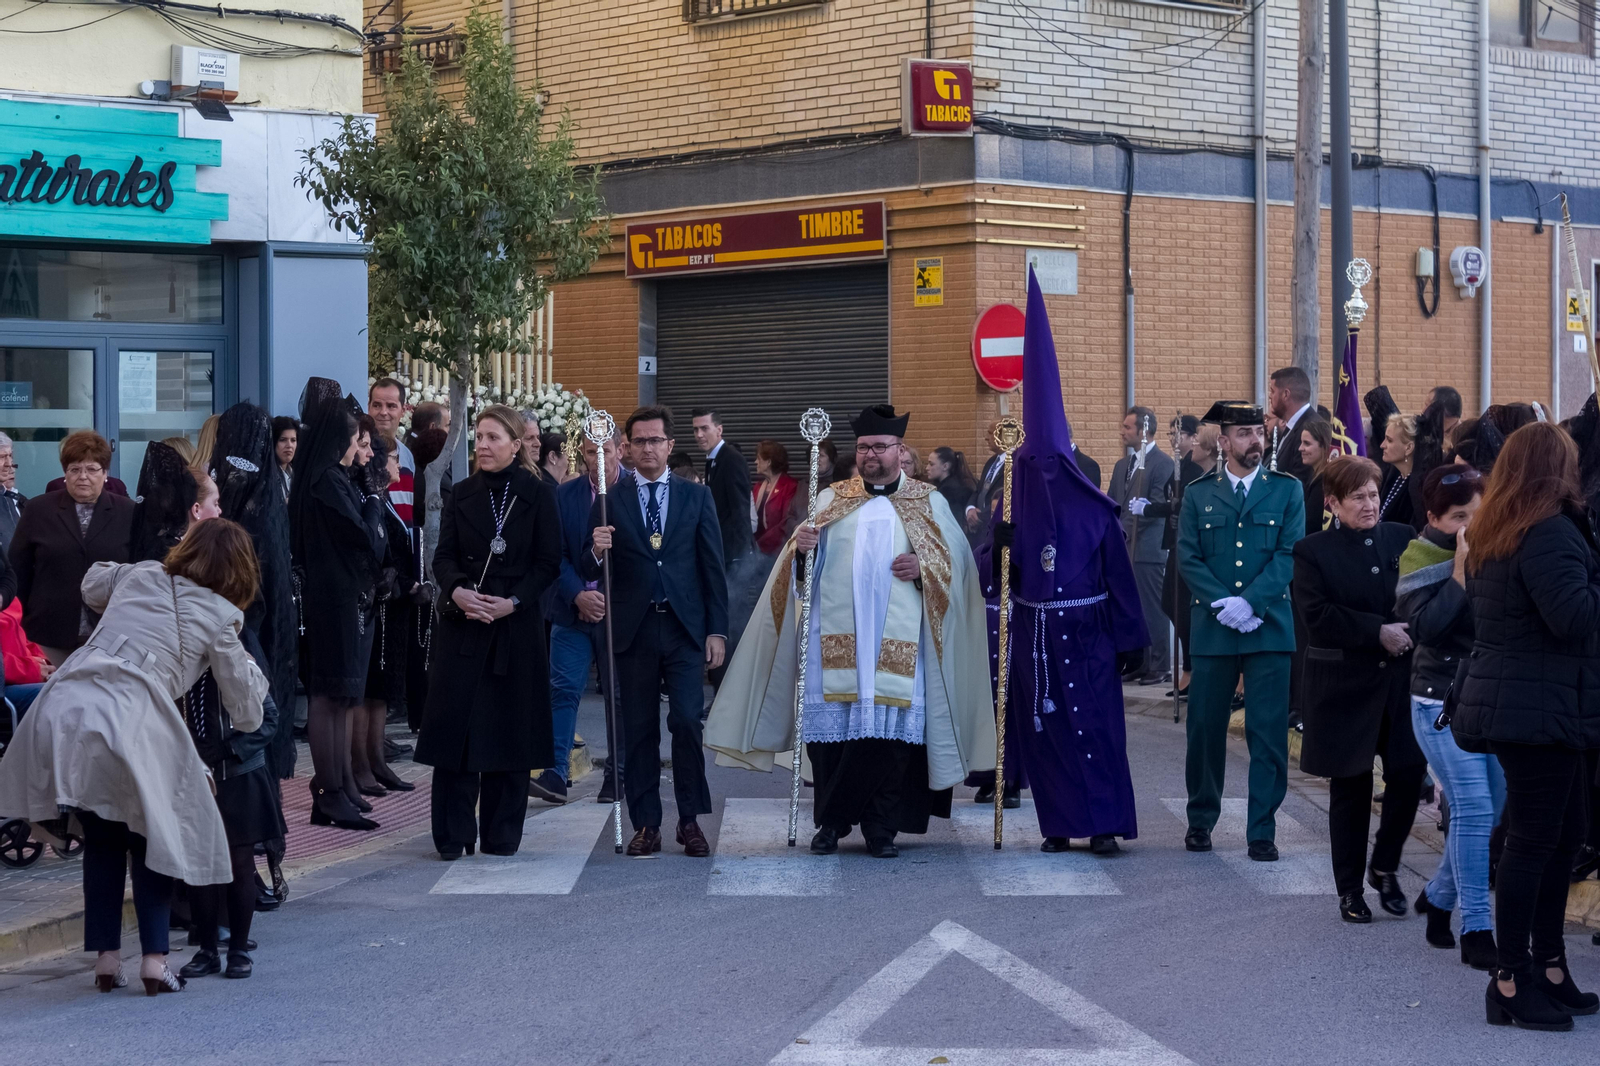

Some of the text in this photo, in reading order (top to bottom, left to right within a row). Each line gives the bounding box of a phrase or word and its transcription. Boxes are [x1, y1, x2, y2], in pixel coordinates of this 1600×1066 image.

[925, 105, 971, 122] TABACOS
[656, 209, 864, 251] TABACOS TIMBRE
[689, 255, 702, 265] EXP.
[645, 361, 651, 371] 2
